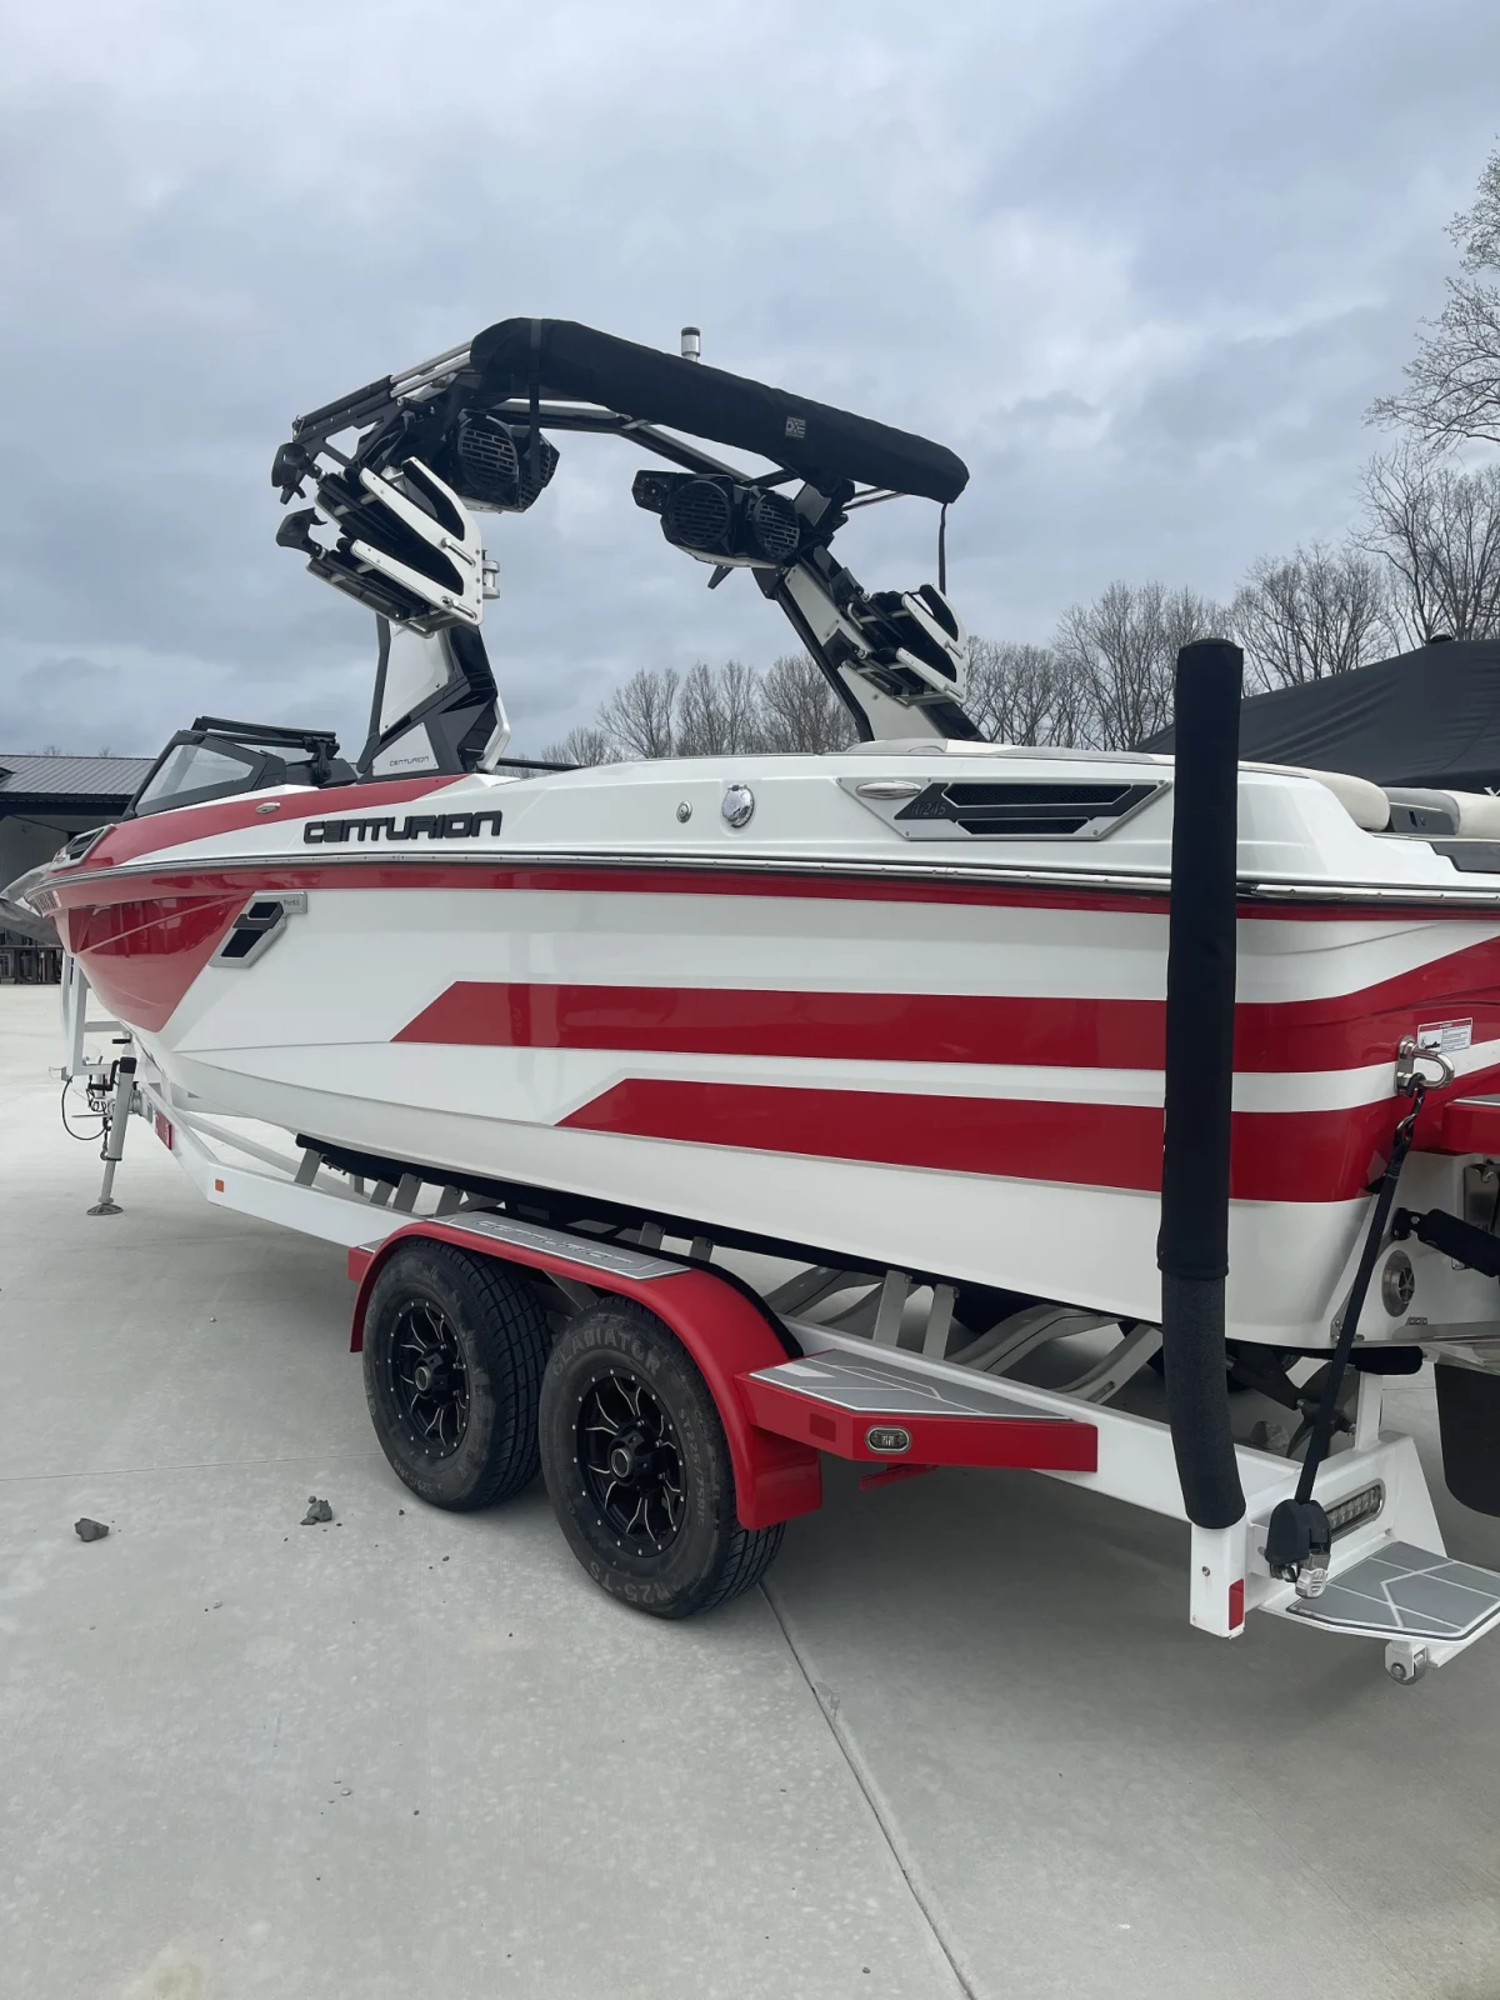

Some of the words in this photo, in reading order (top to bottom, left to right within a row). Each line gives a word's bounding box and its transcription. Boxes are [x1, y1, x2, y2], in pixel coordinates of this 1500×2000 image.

[389, 755, 430, 767] CENTURION
[303, 810, 503, 844] CENTURION
[551, 1327, 661, 1378] GLADIATOR
